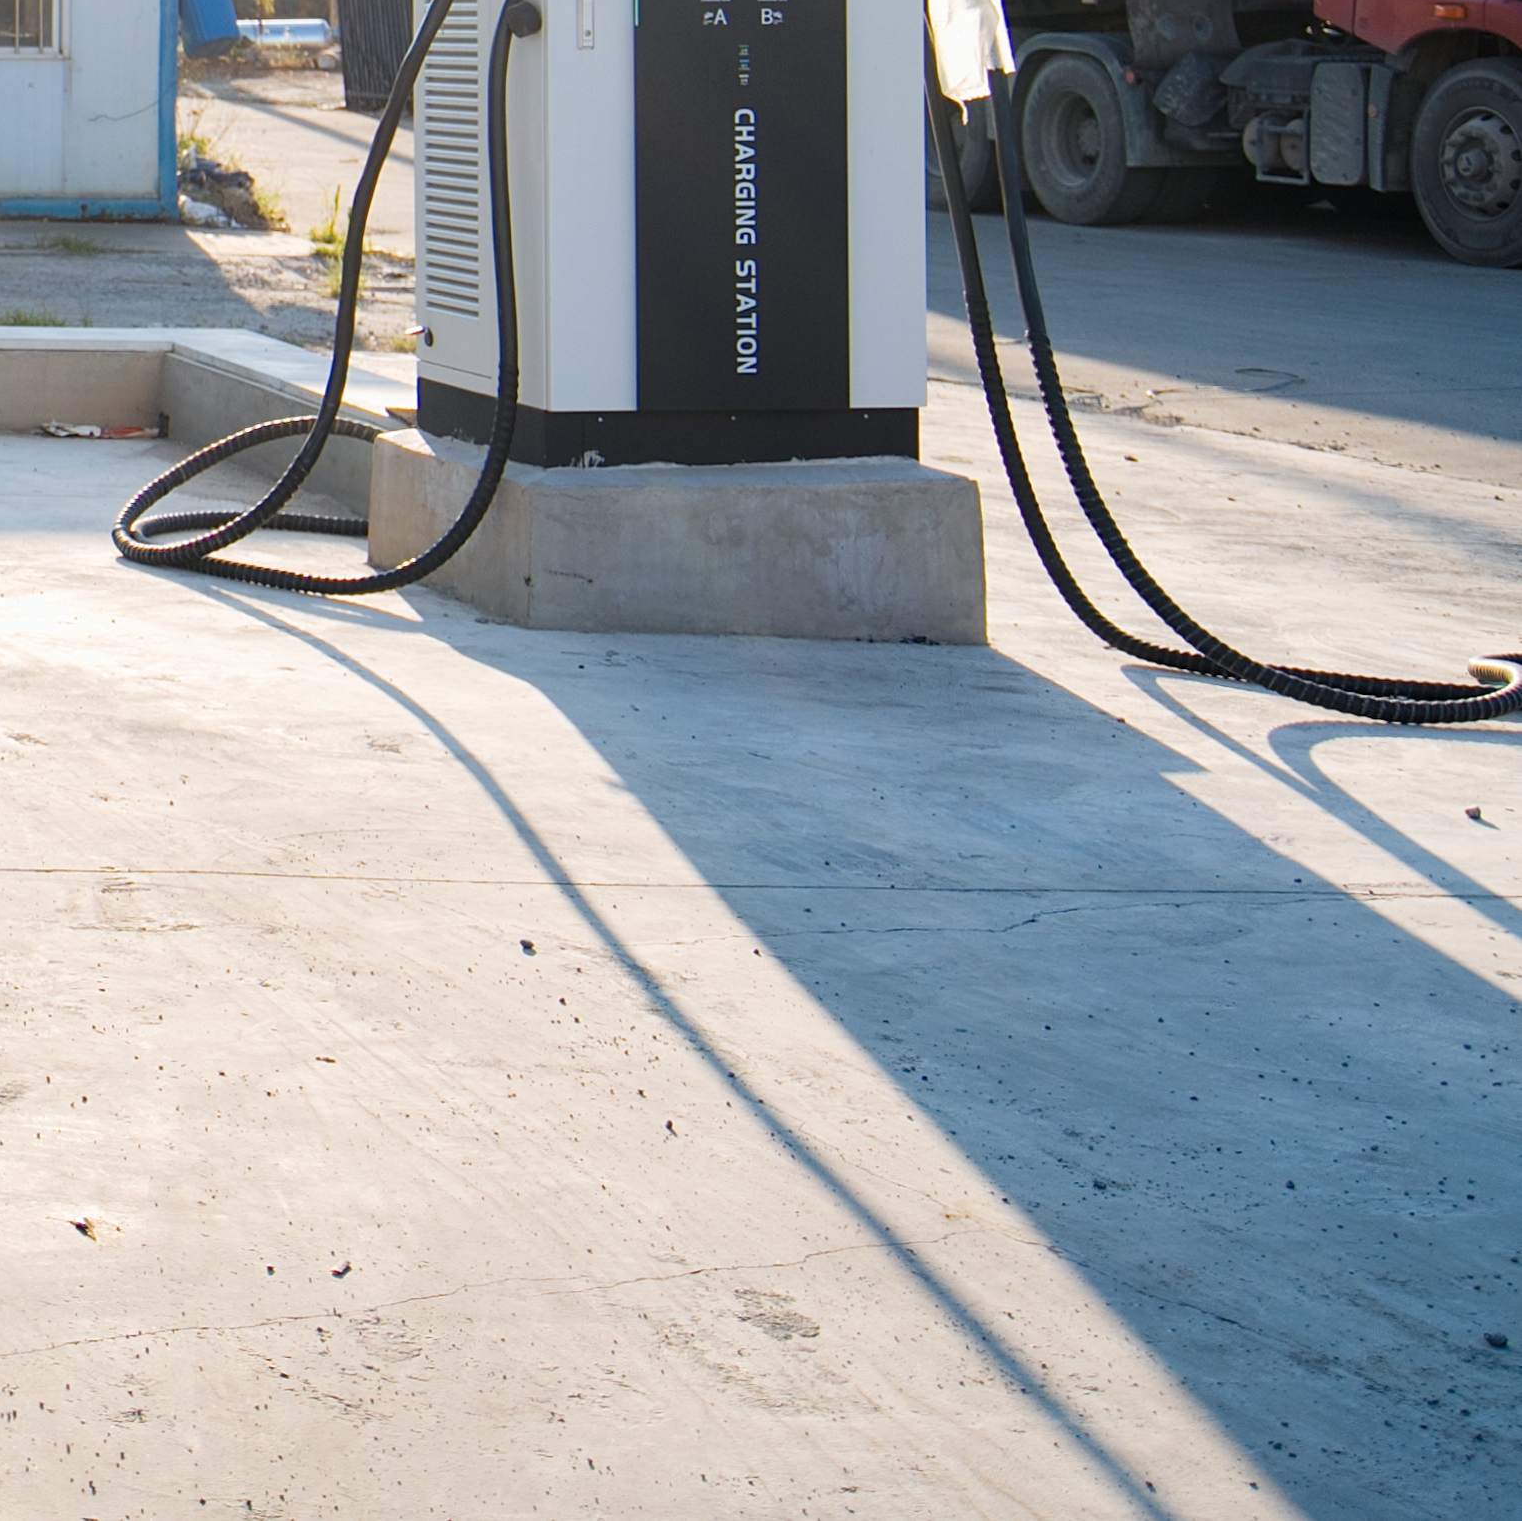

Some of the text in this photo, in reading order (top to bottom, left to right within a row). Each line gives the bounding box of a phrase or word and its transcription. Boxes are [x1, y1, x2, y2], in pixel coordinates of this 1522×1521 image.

[713, 8, 728, 26] A
[761, 8, 774, 25] B
[734, 108, 758, 374] CHARGING STATION
